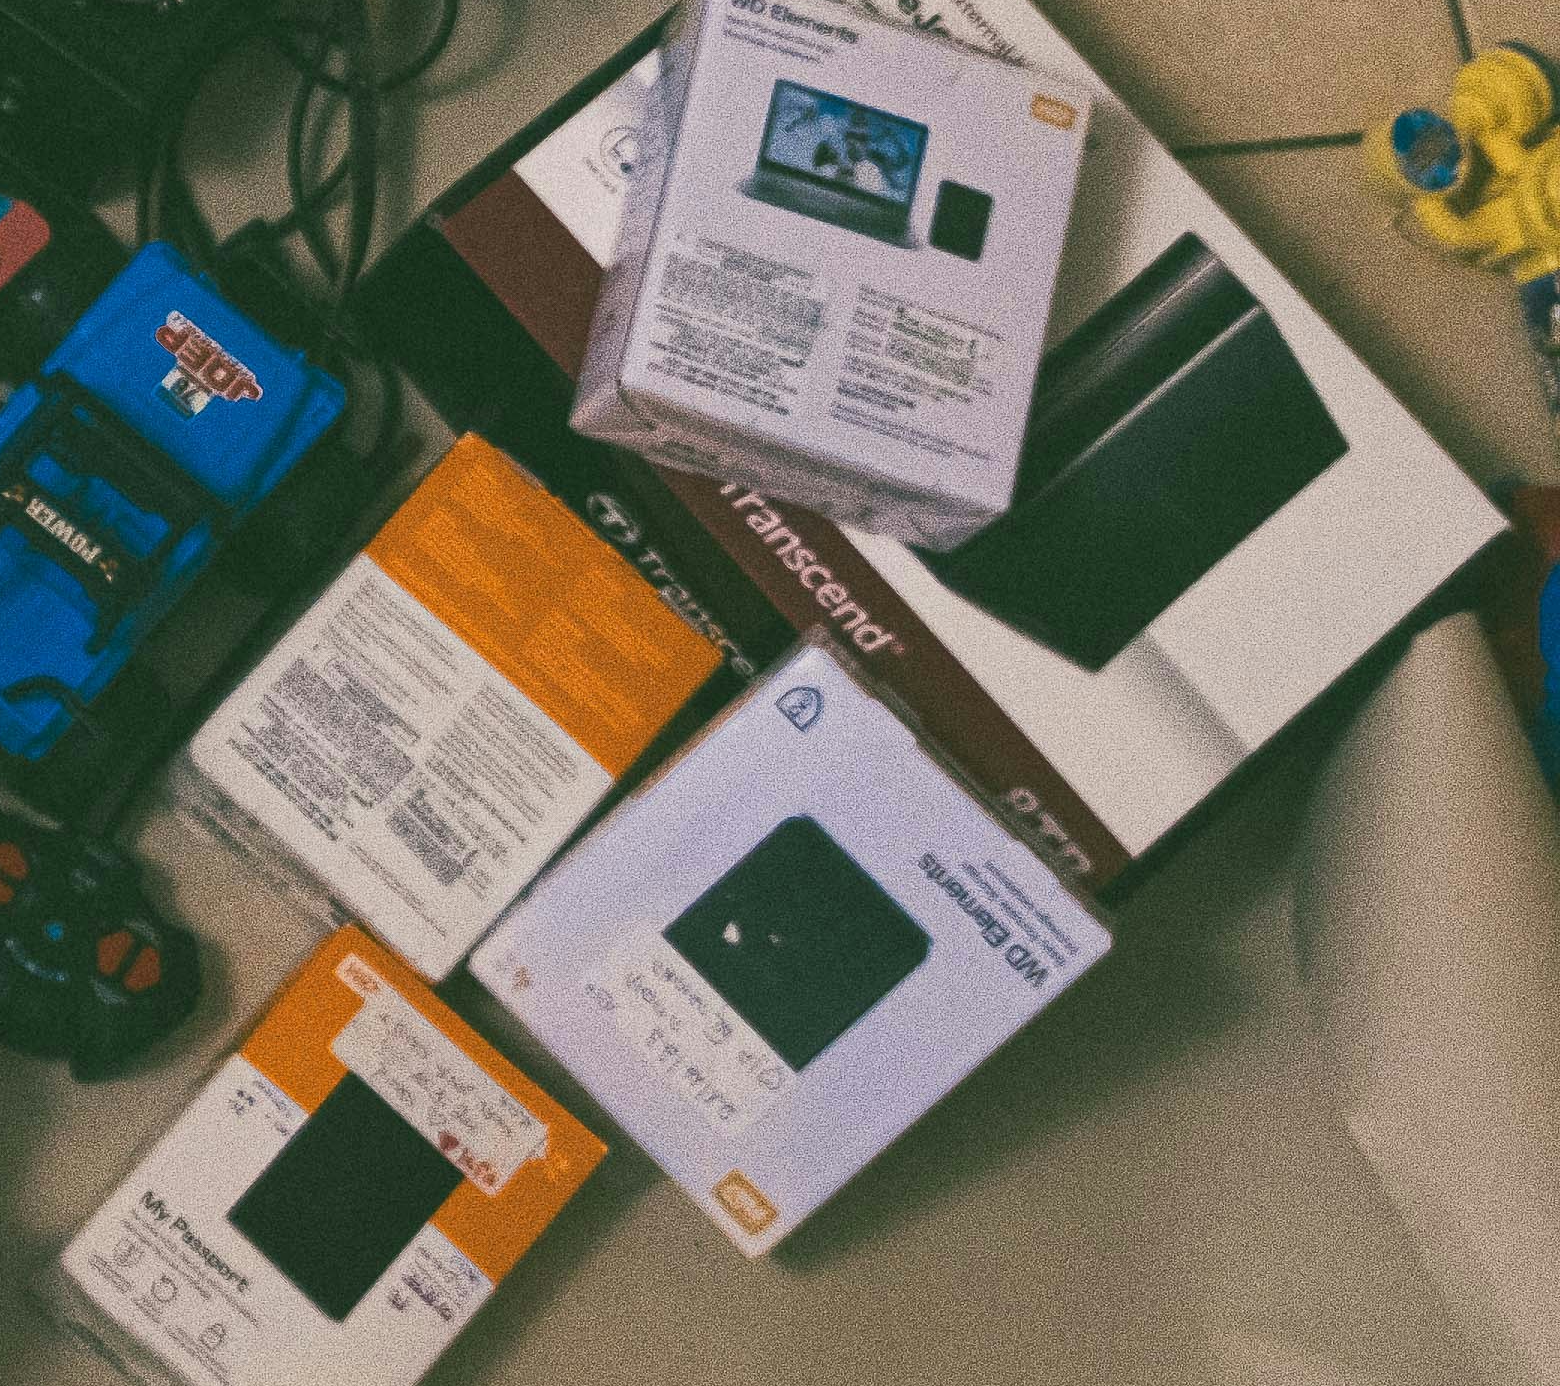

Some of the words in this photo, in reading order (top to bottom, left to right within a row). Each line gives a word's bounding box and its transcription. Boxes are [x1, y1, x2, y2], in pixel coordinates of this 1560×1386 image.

[768, 1, 861, 45] Elements
[22, 492, 103, 567] POWER
[911, 850, 1012, 950] Elements
[1002, 939, 1051, 989] WD
[136, 1188, 175, 1224] My
[163, 1214, 259, 1293] Passport
